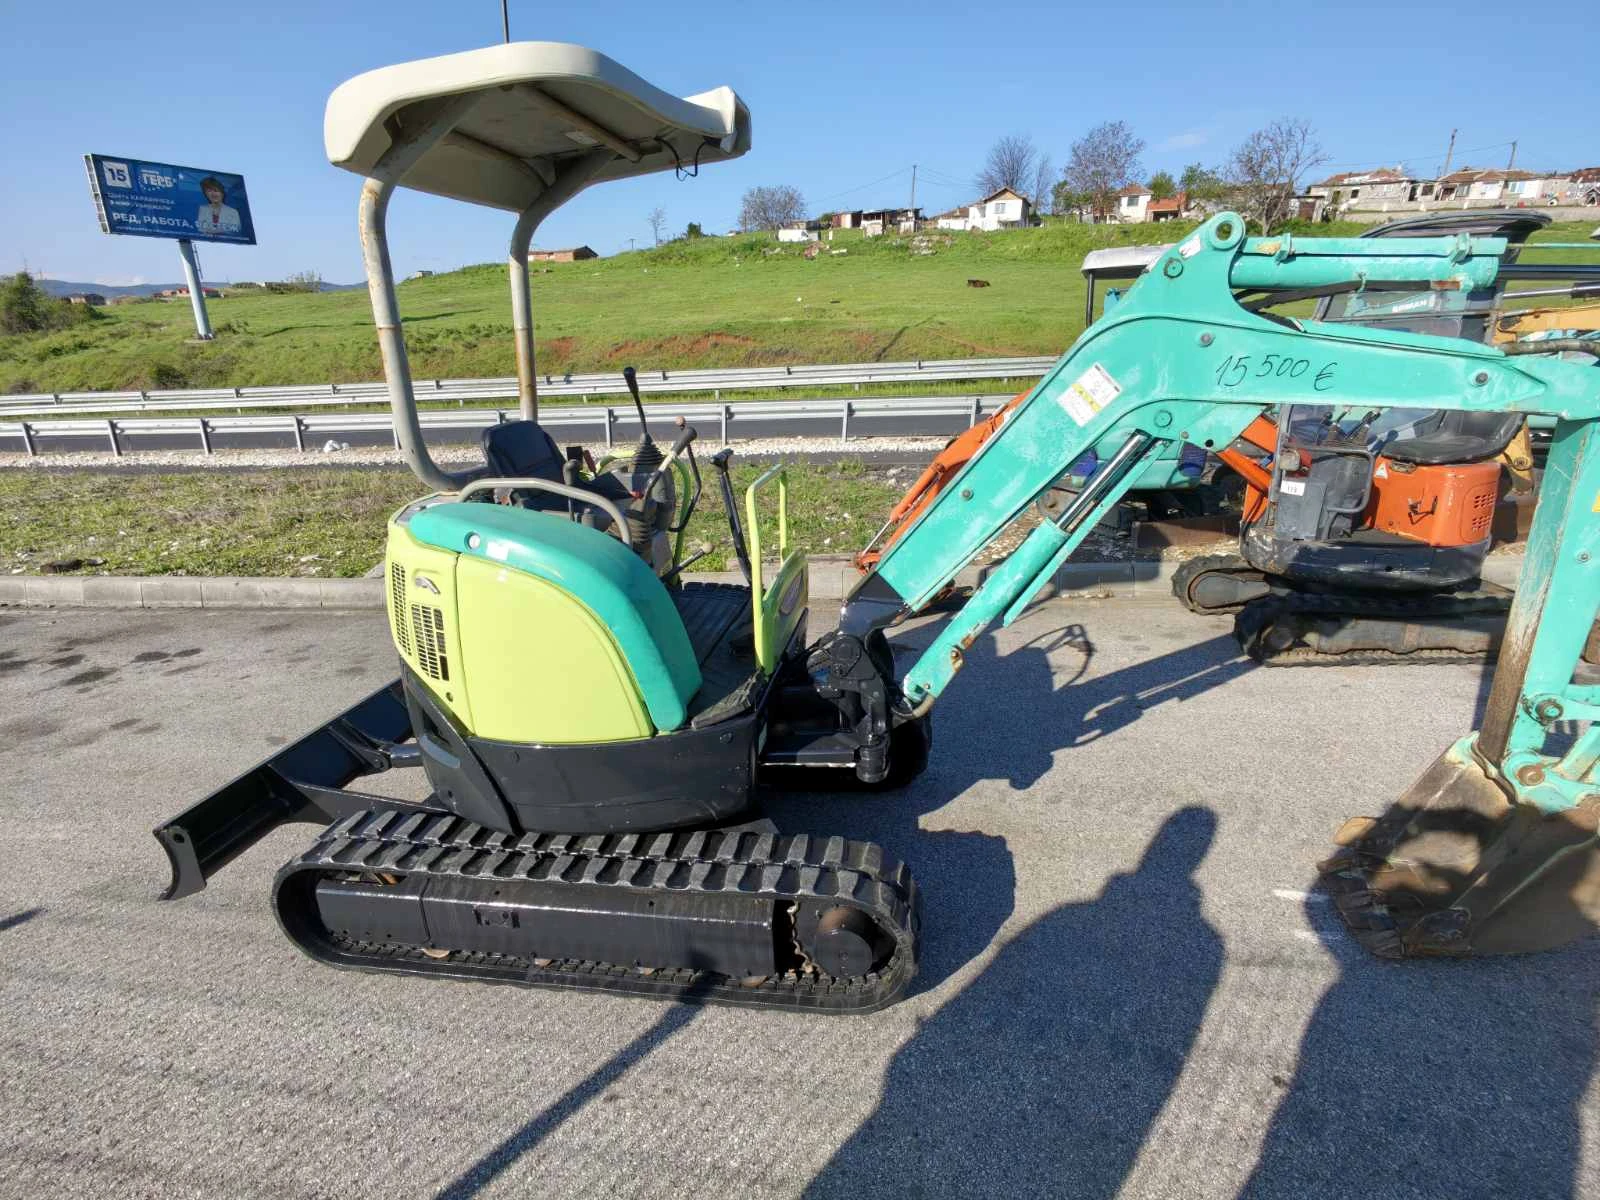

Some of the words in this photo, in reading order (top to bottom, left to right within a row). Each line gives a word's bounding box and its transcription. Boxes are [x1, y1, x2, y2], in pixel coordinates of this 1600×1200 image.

[108, 168, 127, 182] 15
[1215, 355, 1252, 387] 15
[1255, 354, 1310, 378] 500
[1313, 362, 1338, 391] €
